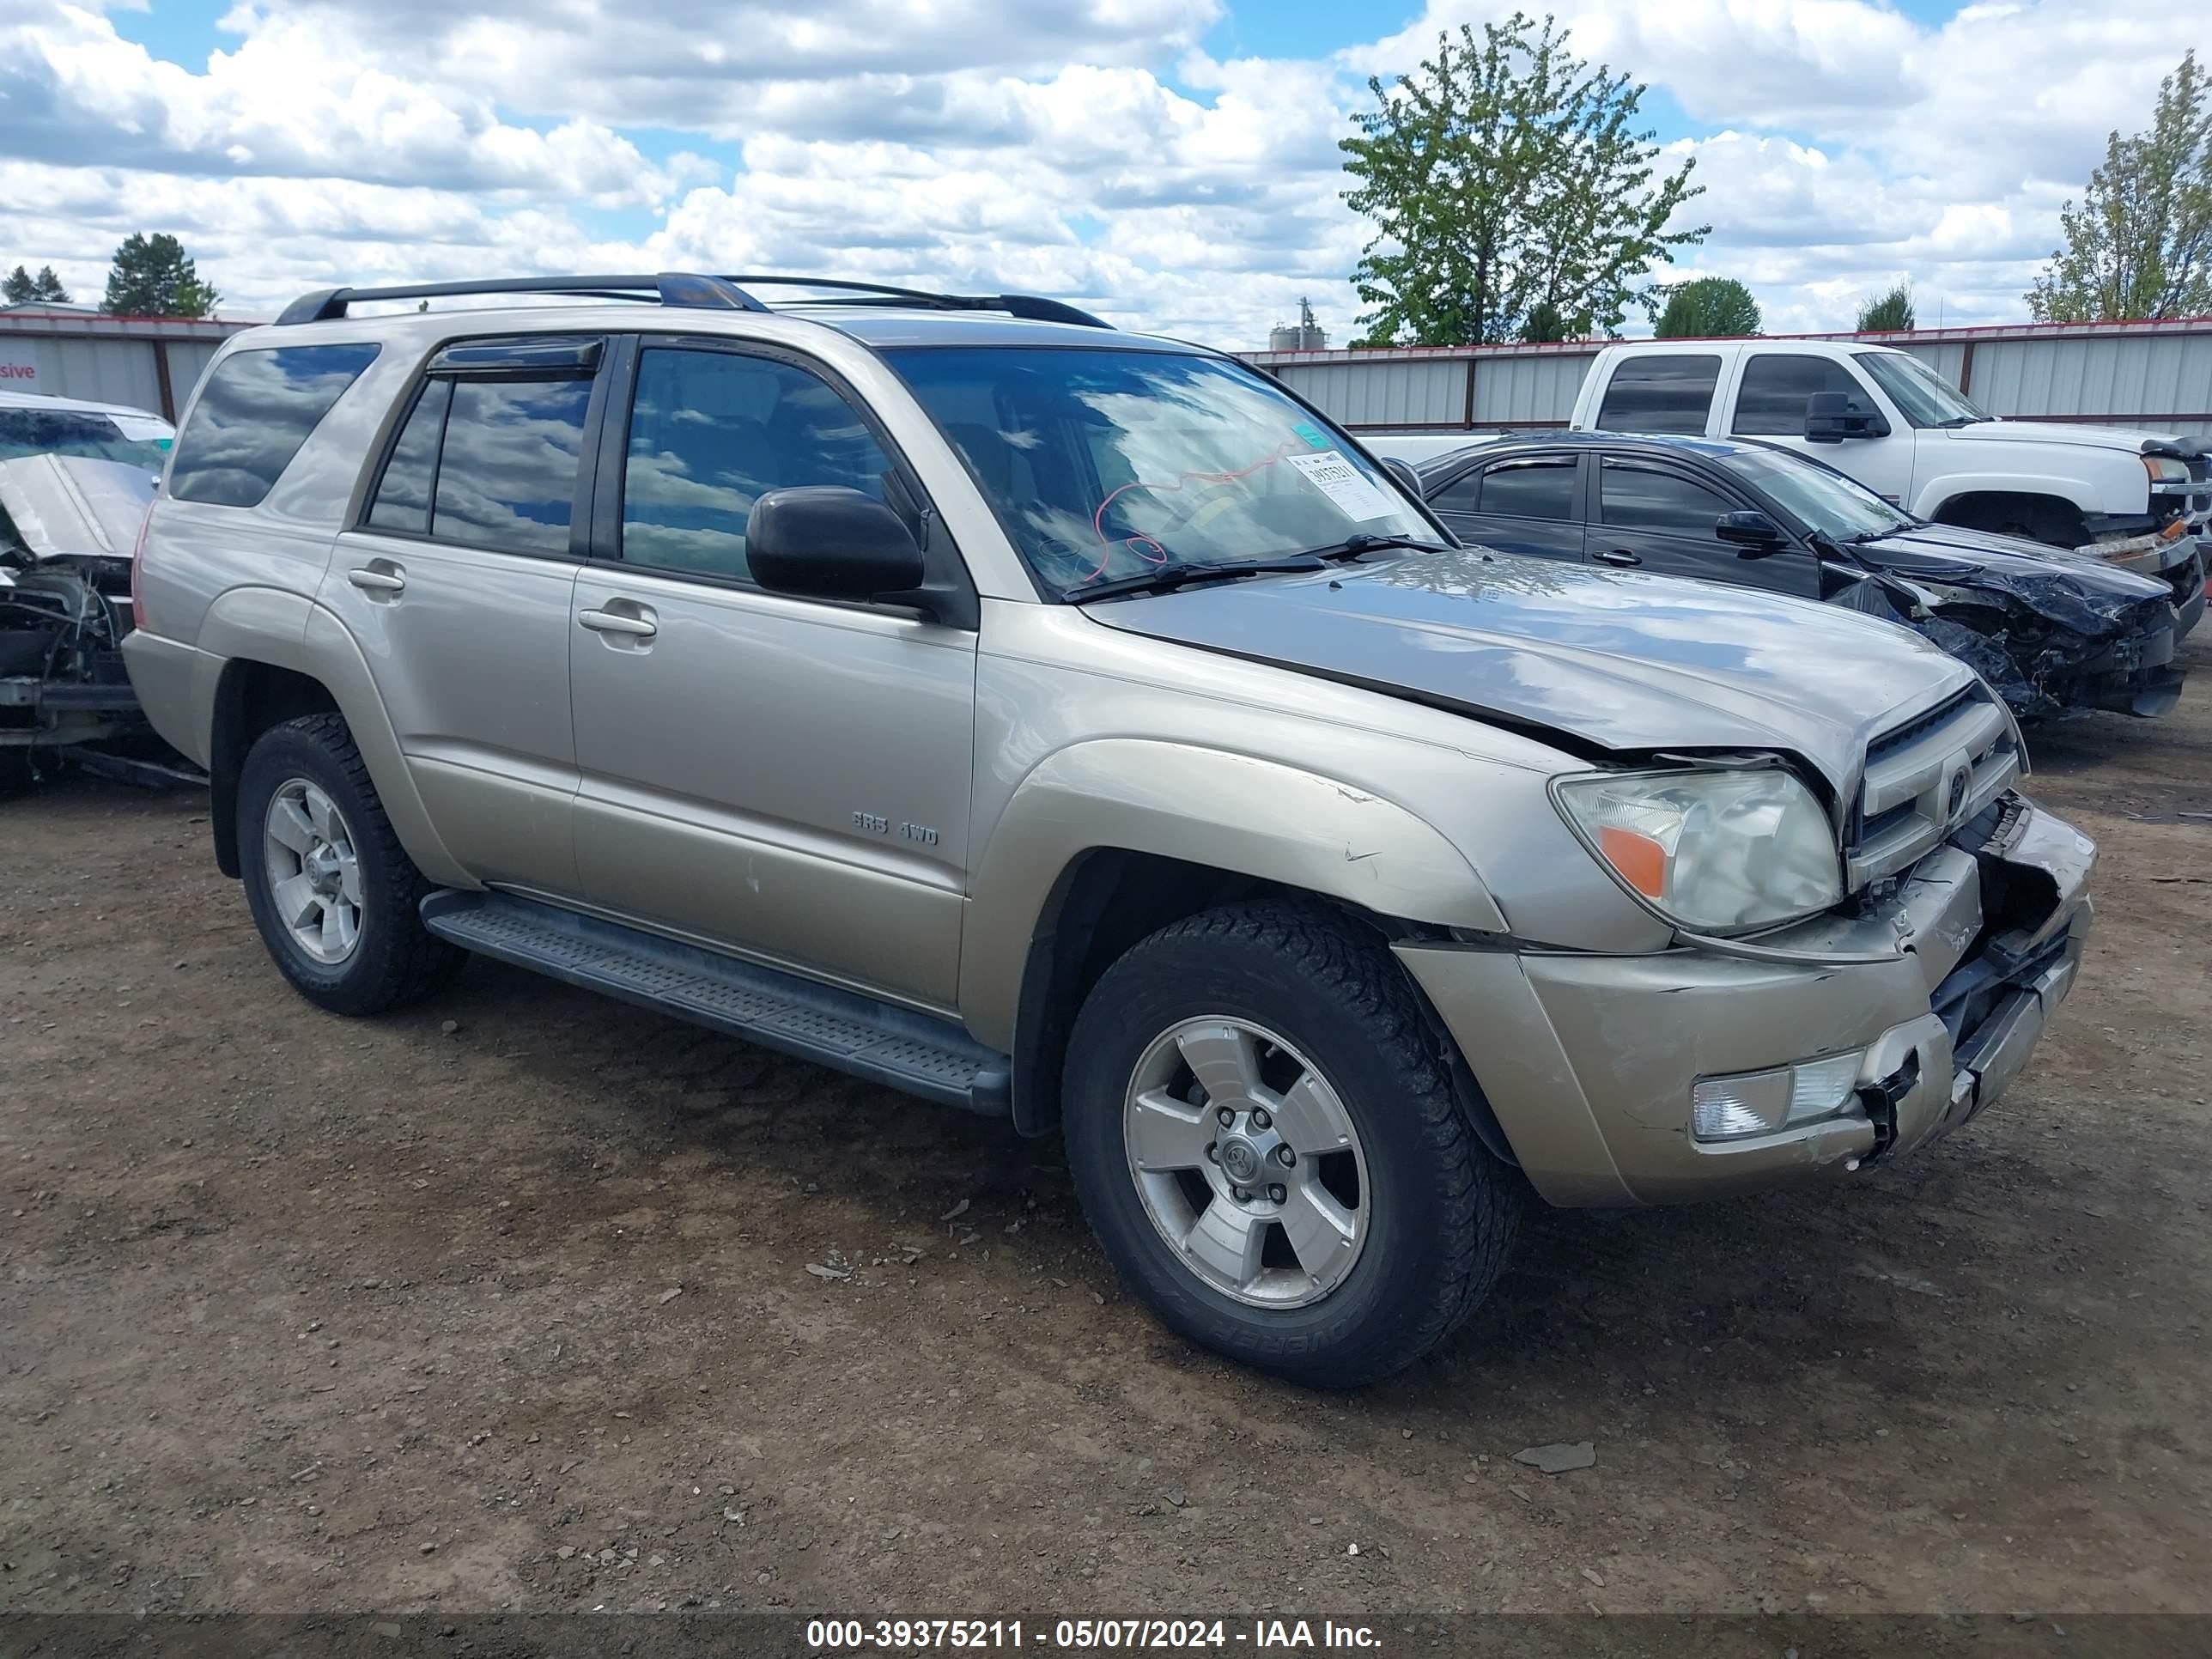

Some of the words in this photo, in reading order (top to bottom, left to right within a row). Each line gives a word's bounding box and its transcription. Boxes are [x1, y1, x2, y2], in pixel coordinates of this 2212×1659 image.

[0, 362, 35, 379] sive
[1309, 465, 1356, 483] 39375211
[852, 811, 888, 834] SR5
[900, 822, 939, 845] 4WD
